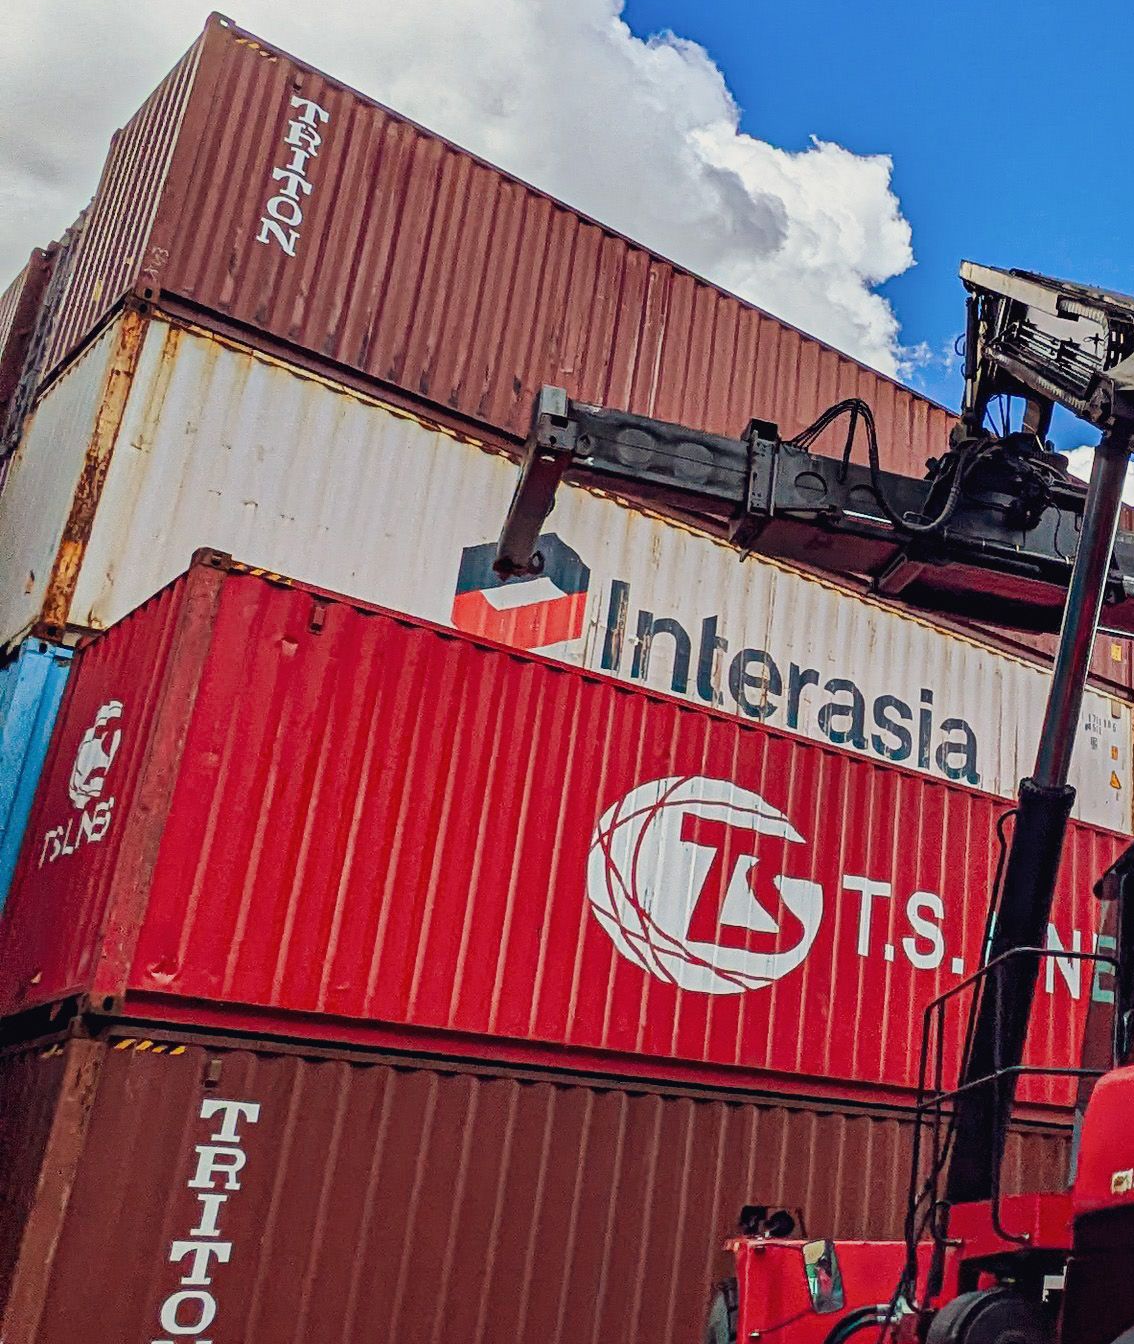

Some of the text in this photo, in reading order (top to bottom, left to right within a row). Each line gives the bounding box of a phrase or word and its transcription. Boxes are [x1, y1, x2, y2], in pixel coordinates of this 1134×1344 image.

[256, 95, 330, 257] TRITON
[601, 579, 980, 785] Interasia
[842, 874, 966, 975] T.S.
